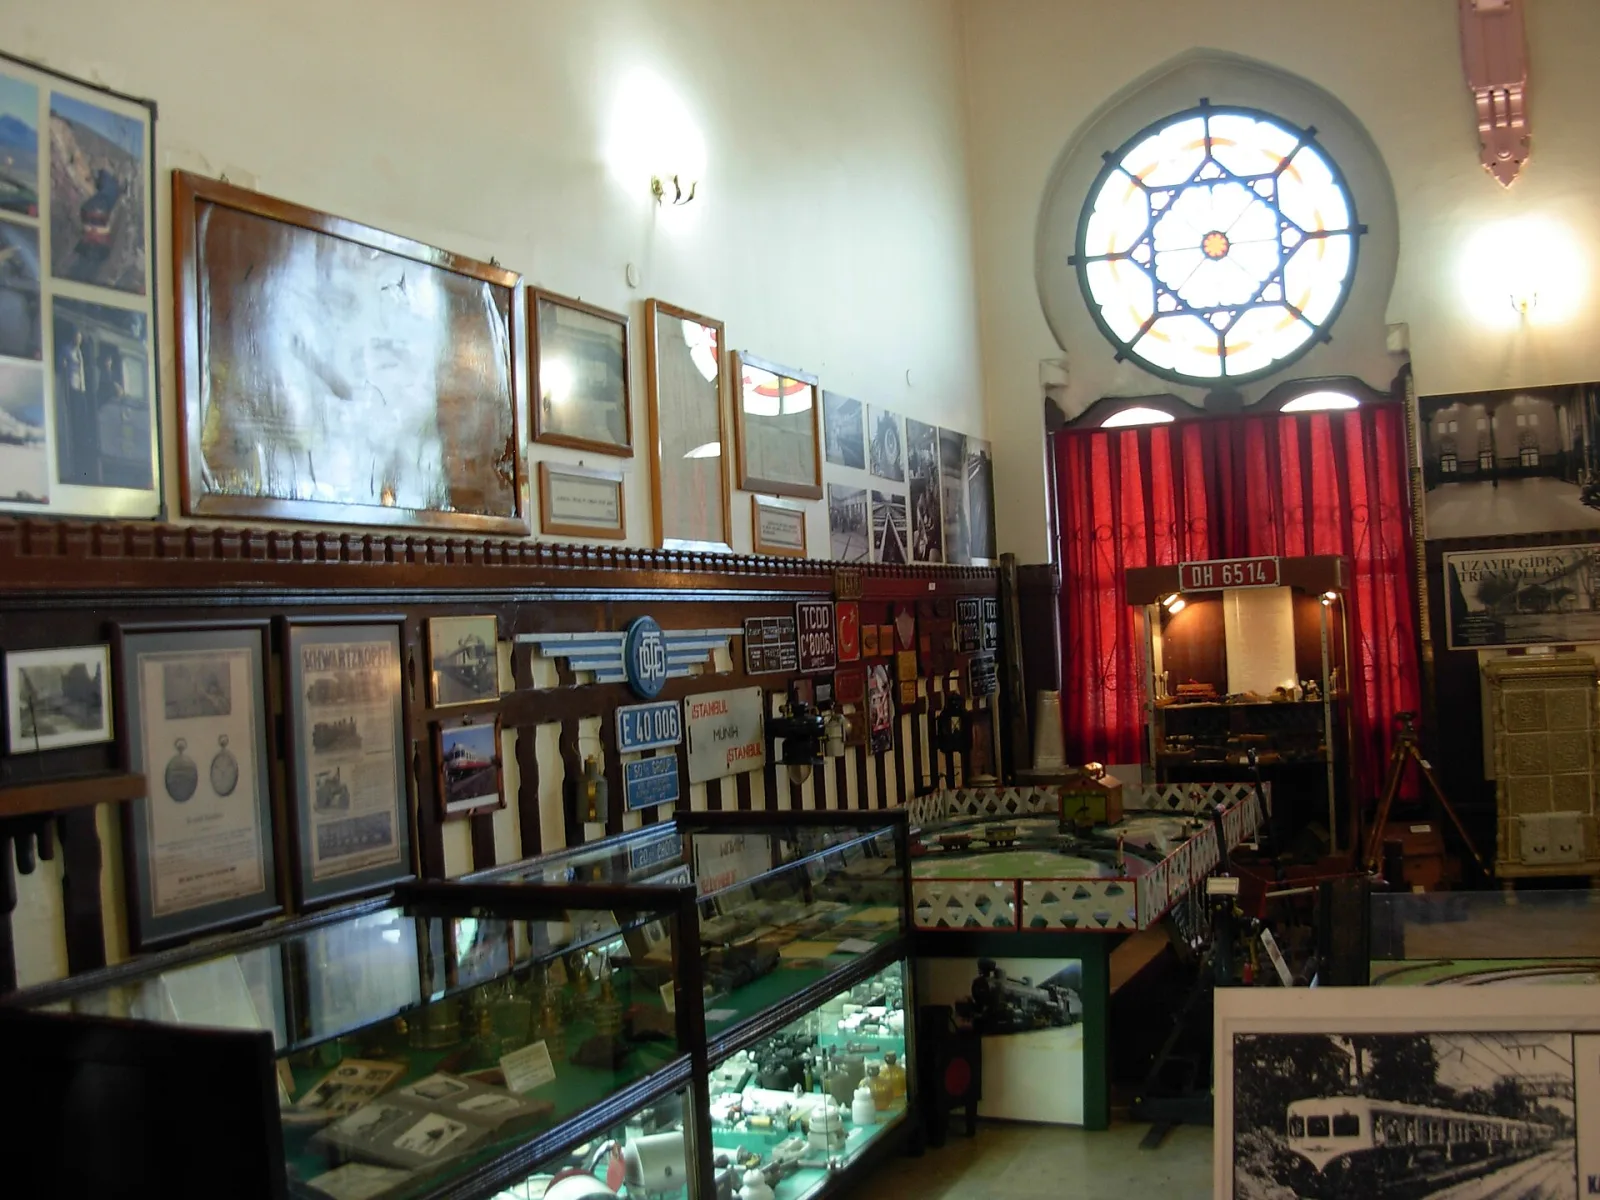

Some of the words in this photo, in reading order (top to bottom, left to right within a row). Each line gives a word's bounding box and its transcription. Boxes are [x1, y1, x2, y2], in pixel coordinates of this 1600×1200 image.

[1192, 566, 1213, 587] DH
[1222, 562, 1266, 584] 6514
[802, 606, 829, 629] TCDD
[623, 713, 632, 745] E
[636, 711, 651, 742] 40
[655, 707, 677, 739] 006
